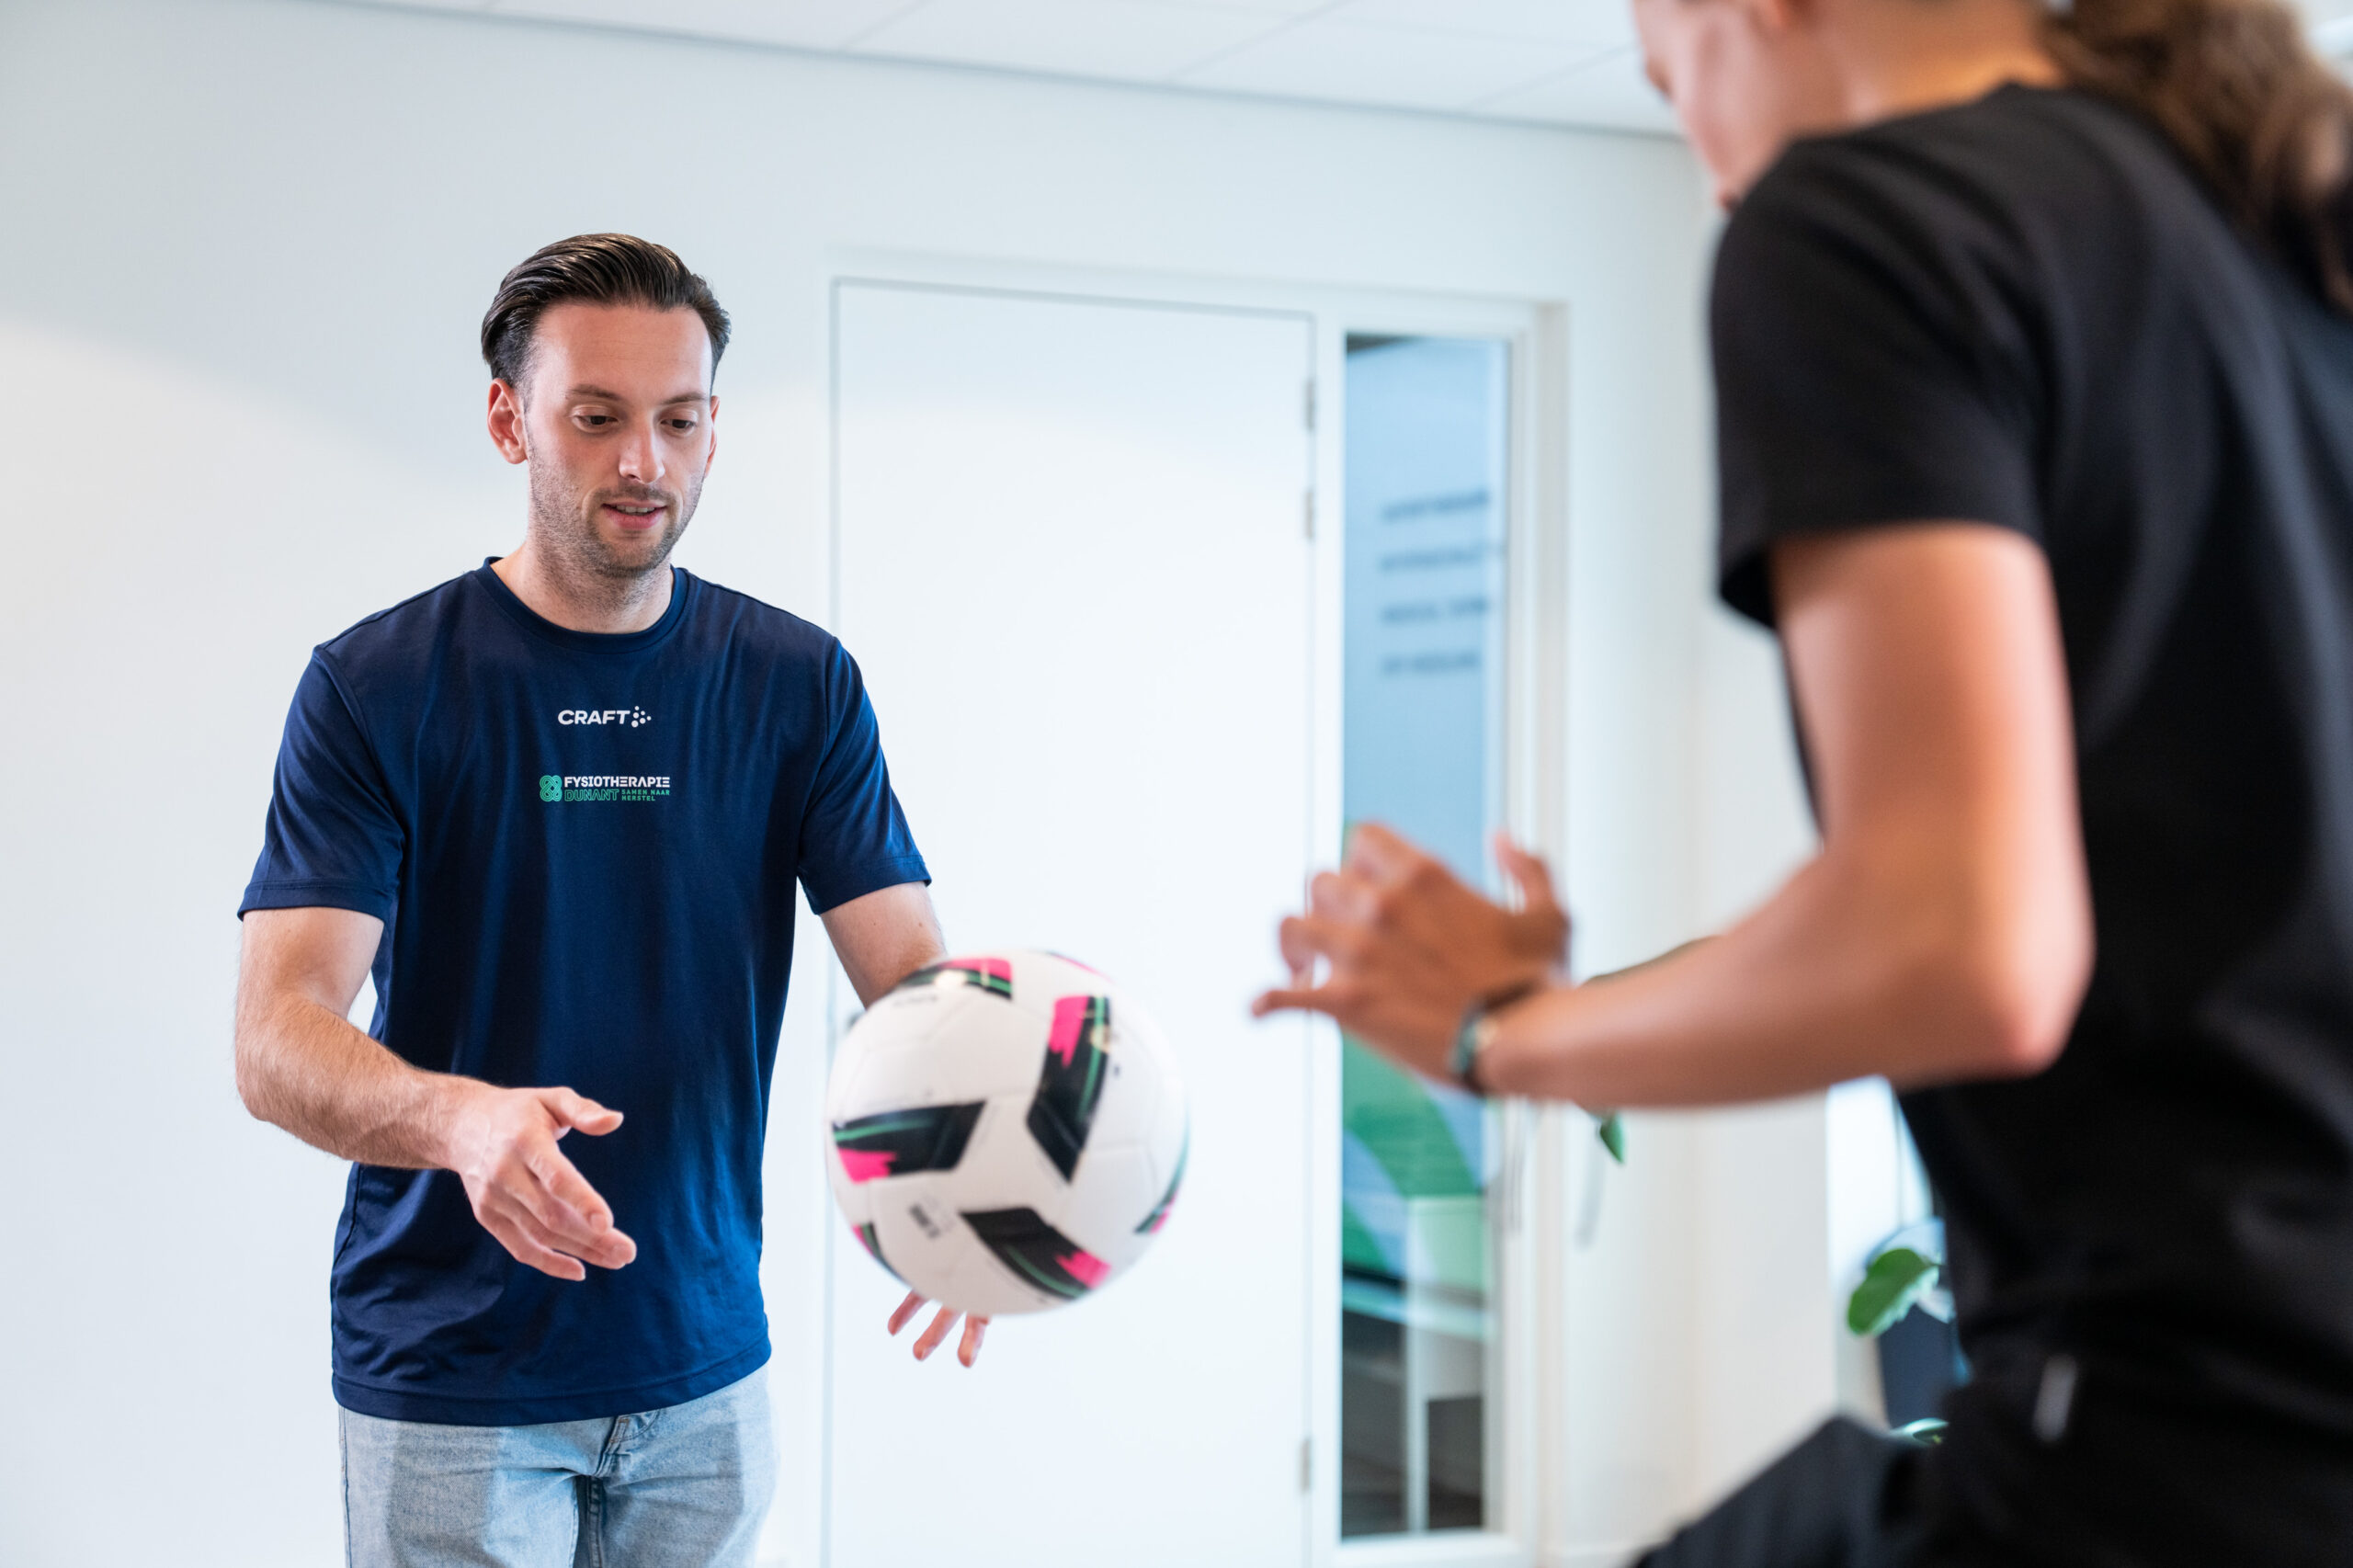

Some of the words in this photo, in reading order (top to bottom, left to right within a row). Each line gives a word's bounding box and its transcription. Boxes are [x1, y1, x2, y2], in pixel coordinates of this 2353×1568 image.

[558, 710, 631, 725] CRAFT
[563, 776, 671, 788] FYSIOTHERAPIE
[563, 789, 620, 801] DUNANT
